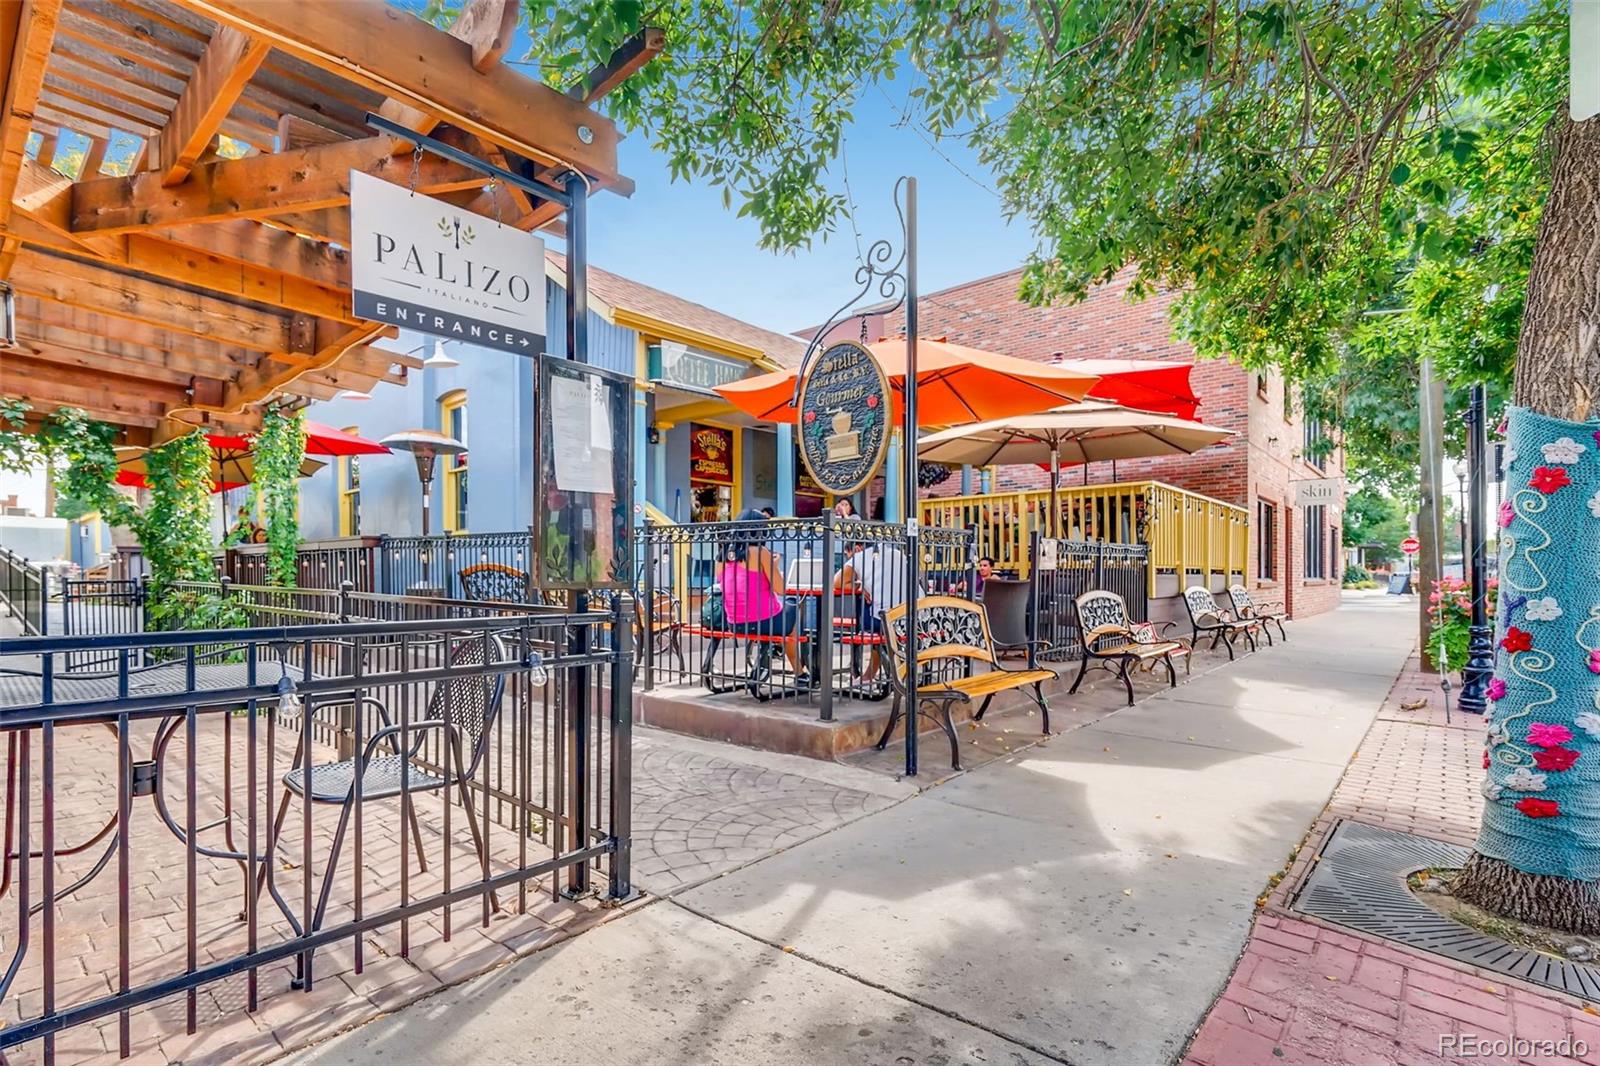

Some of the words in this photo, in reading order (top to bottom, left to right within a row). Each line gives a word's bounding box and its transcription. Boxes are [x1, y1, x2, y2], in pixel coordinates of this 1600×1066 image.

[372, 231, 530, 303] PALIZO
[427, 287, 489, 309] ITALIANO
[377, 302, 514, 345] ENTRANCE
[820, 351, 860, 374] Stella
[816, 384, 865, 406] Gourmet
[696, 432, 727, 452] Stella's
[1301, 483, 1332, 498] skin
